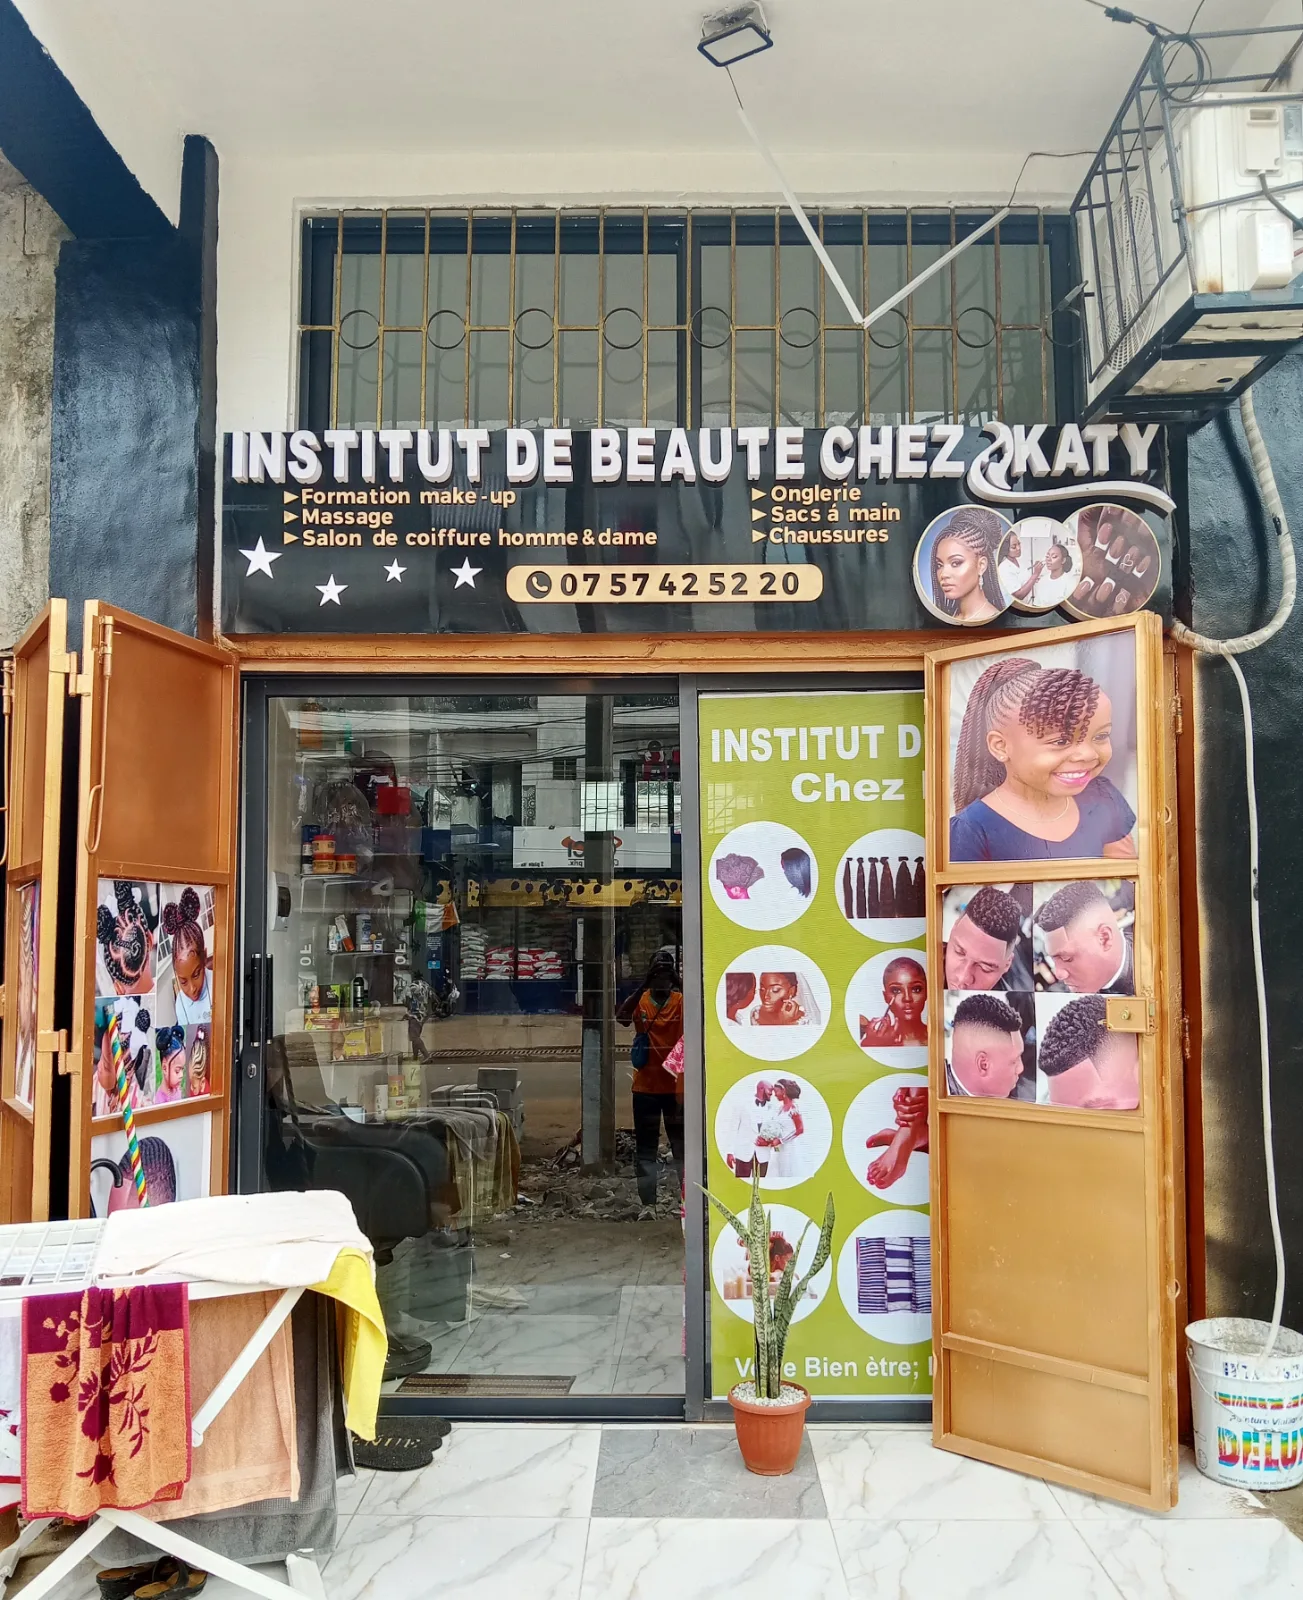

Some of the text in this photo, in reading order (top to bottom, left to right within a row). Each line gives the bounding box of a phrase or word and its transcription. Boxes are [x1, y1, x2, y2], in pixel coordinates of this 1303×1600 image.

[231, 423, 1160, 484] INSTITUT DE BEAUTE CHEZ KATY
[301, 486, 411, 505] Formation
[770, 482, 862, 506] Onglerie
[302, 508, 394, 528] Massage
[771, 505, 821, 523] Sacs
[849, 502, 901, 522] main
[302, 529, 362, 547] Salon
[372, 528, 398, 547] de
[405, 528, 492, 547] coiffure
[769, 526, 889, 544] Chaussures
[711, 725, 885, 762] INSTITUT
[791, 772, 905, 803] Chez
[804, 1357, 858, 1377] Bien
[865, 1356, 919, 1379] être;
